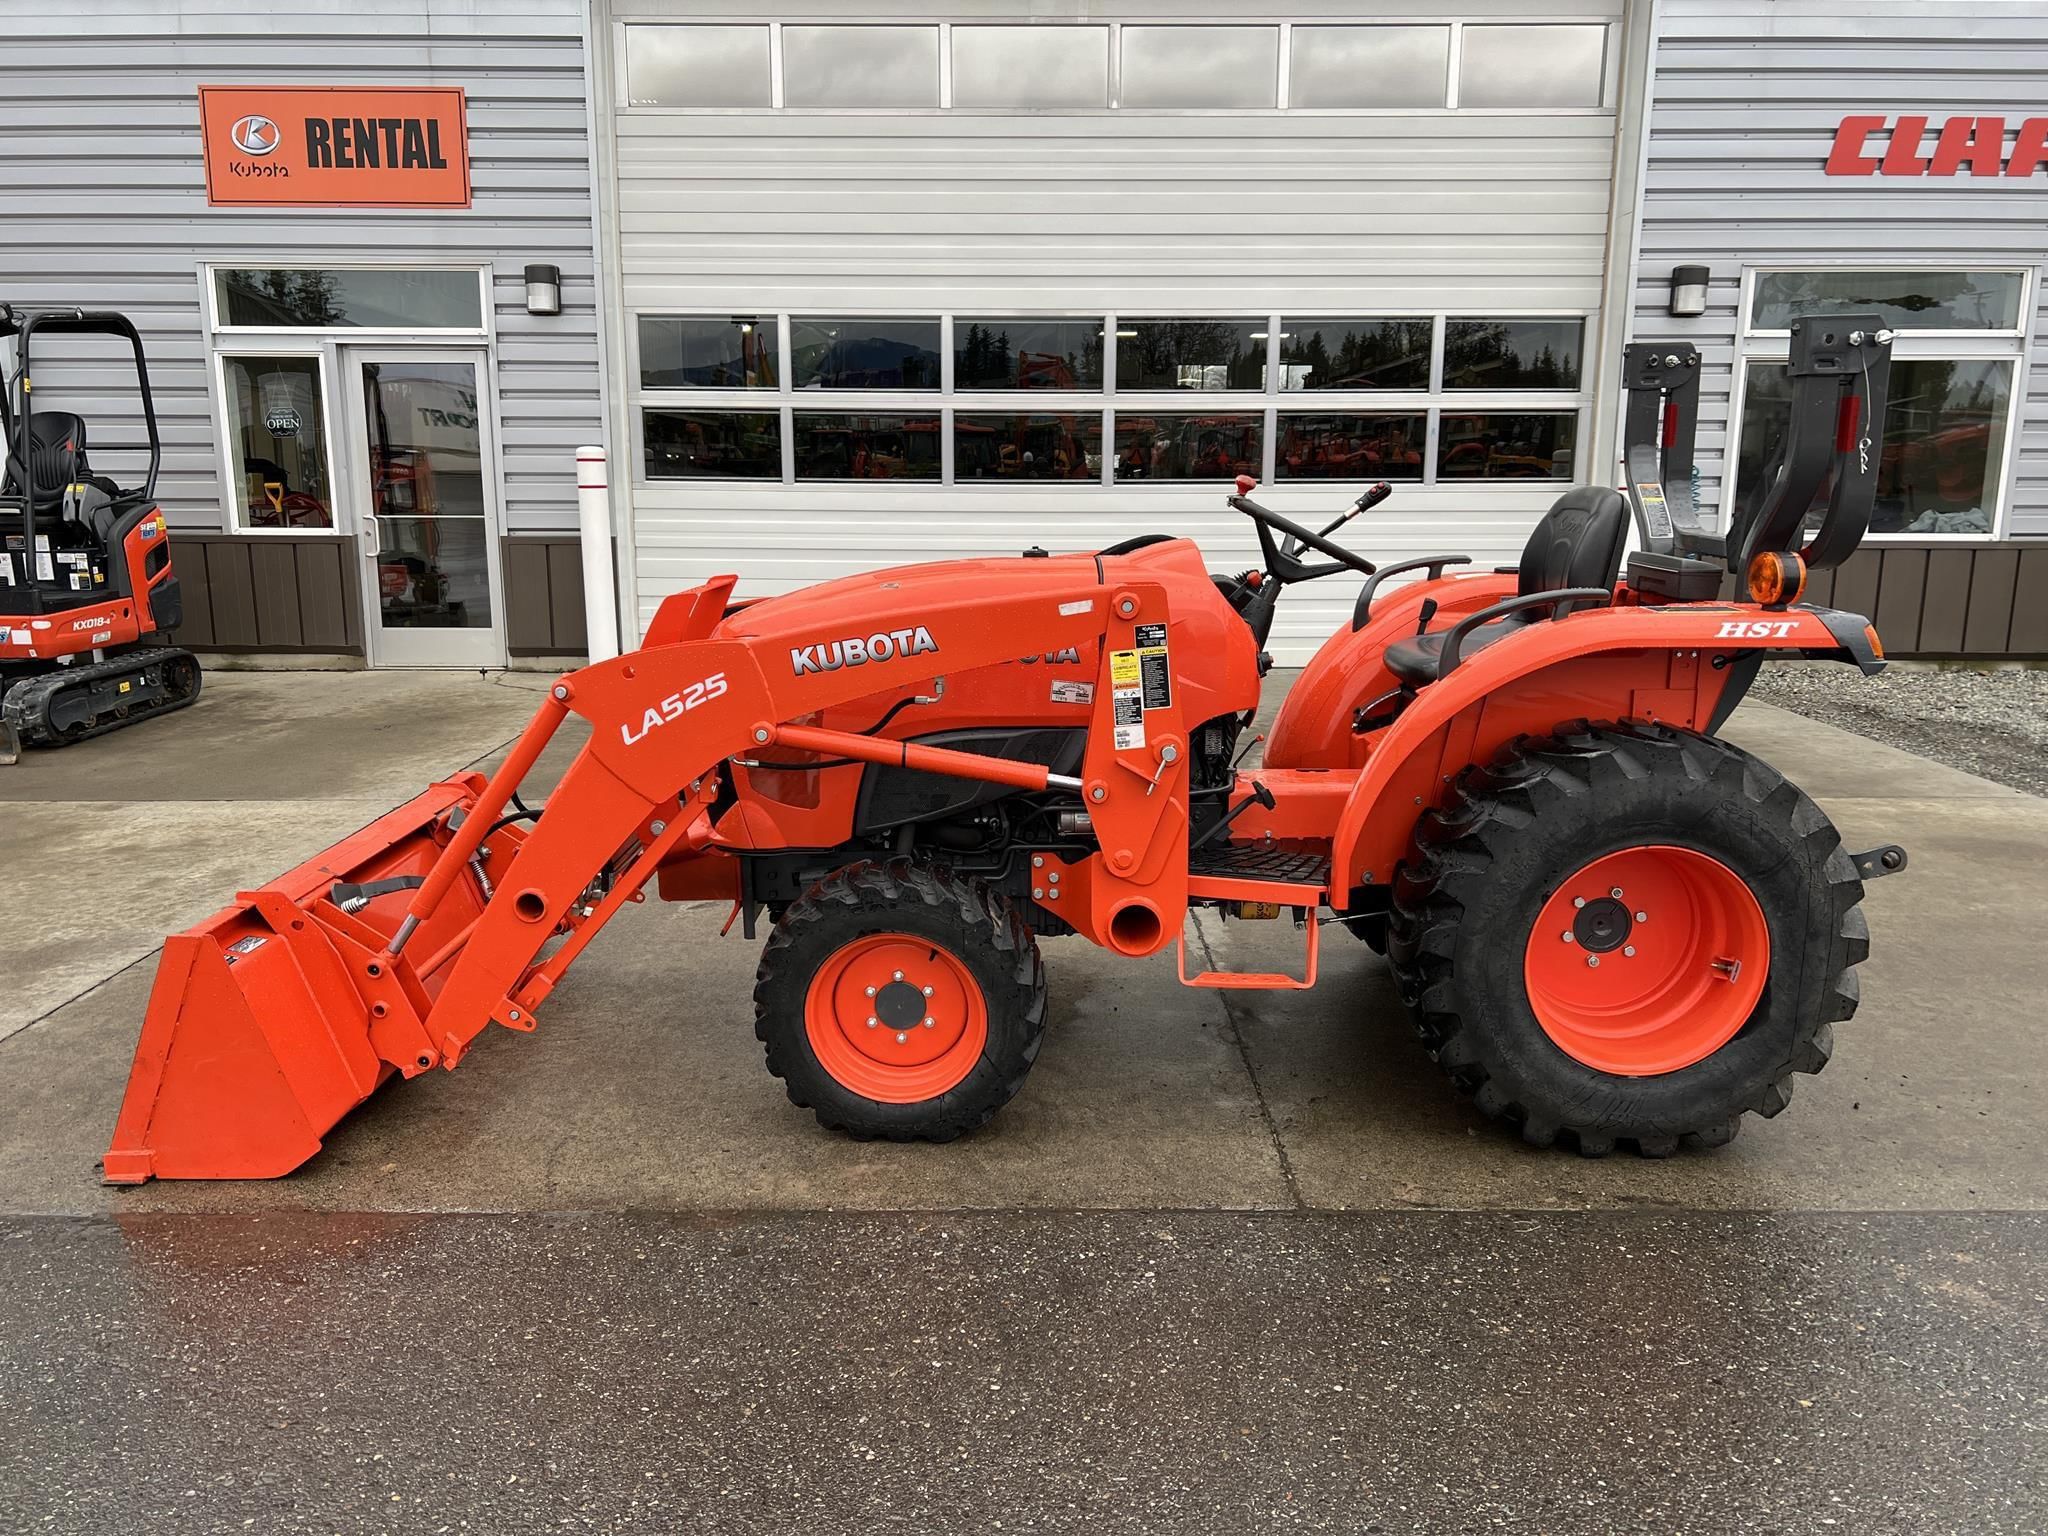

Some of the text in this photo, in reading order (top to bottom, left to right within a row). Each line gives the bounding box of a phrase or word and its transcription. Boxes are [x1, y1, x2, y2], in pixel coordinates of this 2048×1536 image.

[305, 118, 447, 169] RENTAL
[229, 161, 289, 177] Kubota
[267, 418, 299, 429] OPEN
[1714, 622, 1800, 638] HST
[790, 625, 939, 676] KUBOTA
[621, 672, 728, 745] LA525
